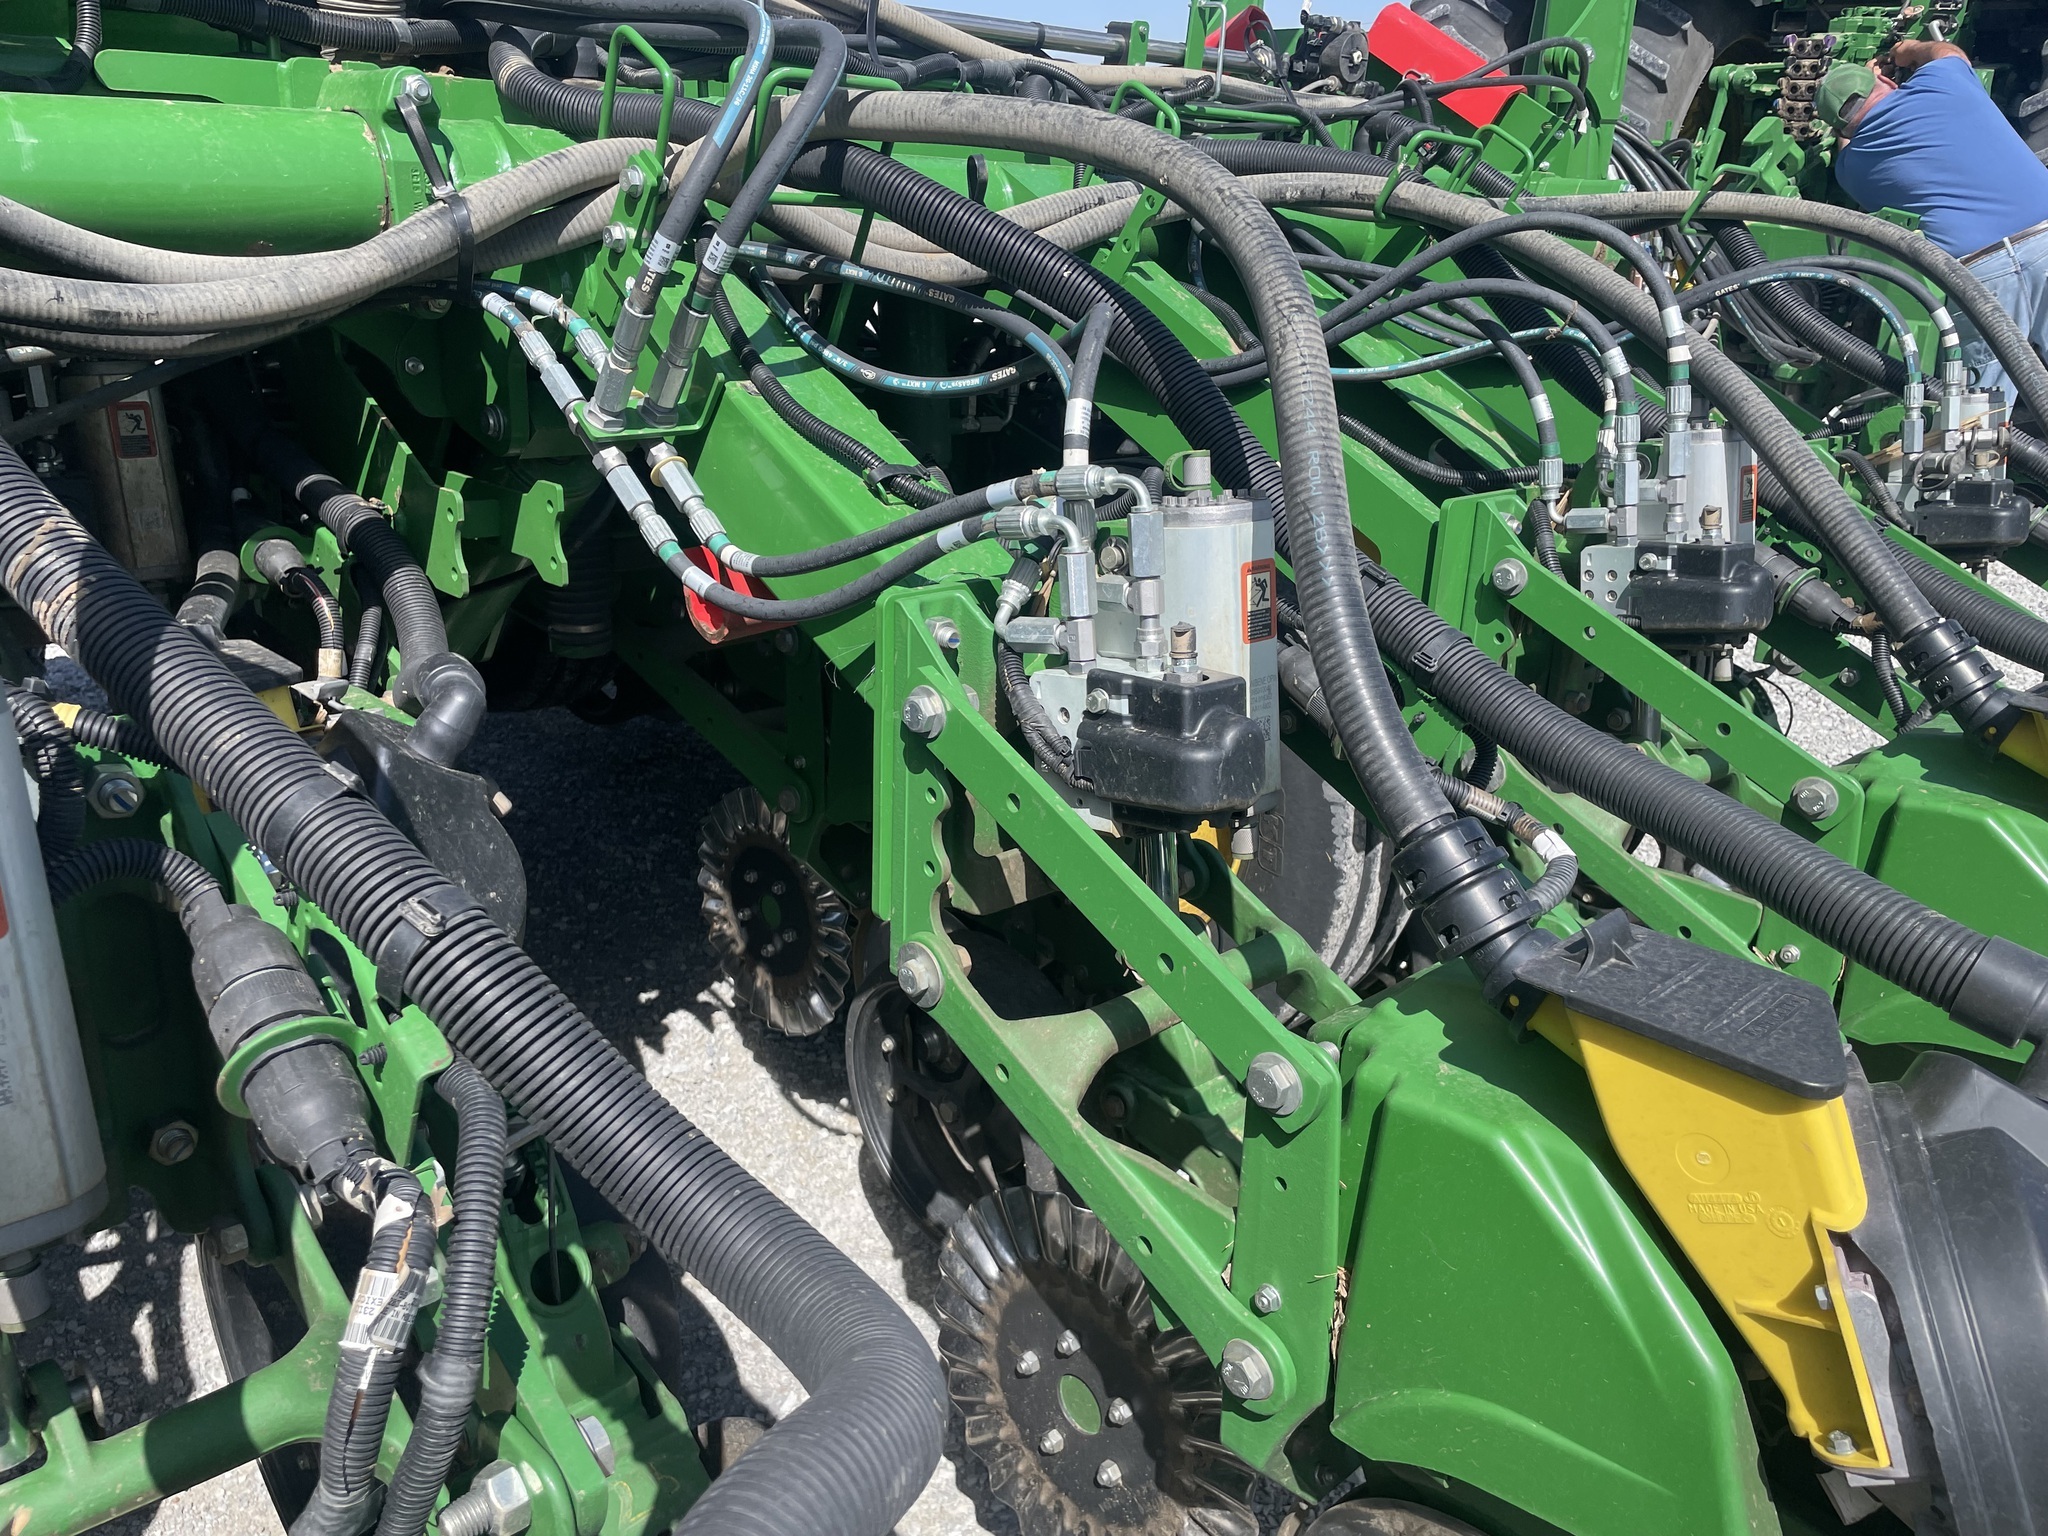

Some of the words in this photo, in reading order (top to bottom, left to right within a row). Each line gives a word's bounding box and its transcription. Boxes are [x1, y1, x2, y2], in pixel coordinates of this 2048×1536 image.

[750, 60, 760, 75] MSHA
[928, 288, 955, 303] GATES
[1715, 284, 1740, 297] GATES
[990, 366, 1016, 381] GATES
[1688, 1203, 1718, 1214] MADE
[1723, 1203, 1735, 1214] IN
[1739, 1204, 1765, 1214] USA
